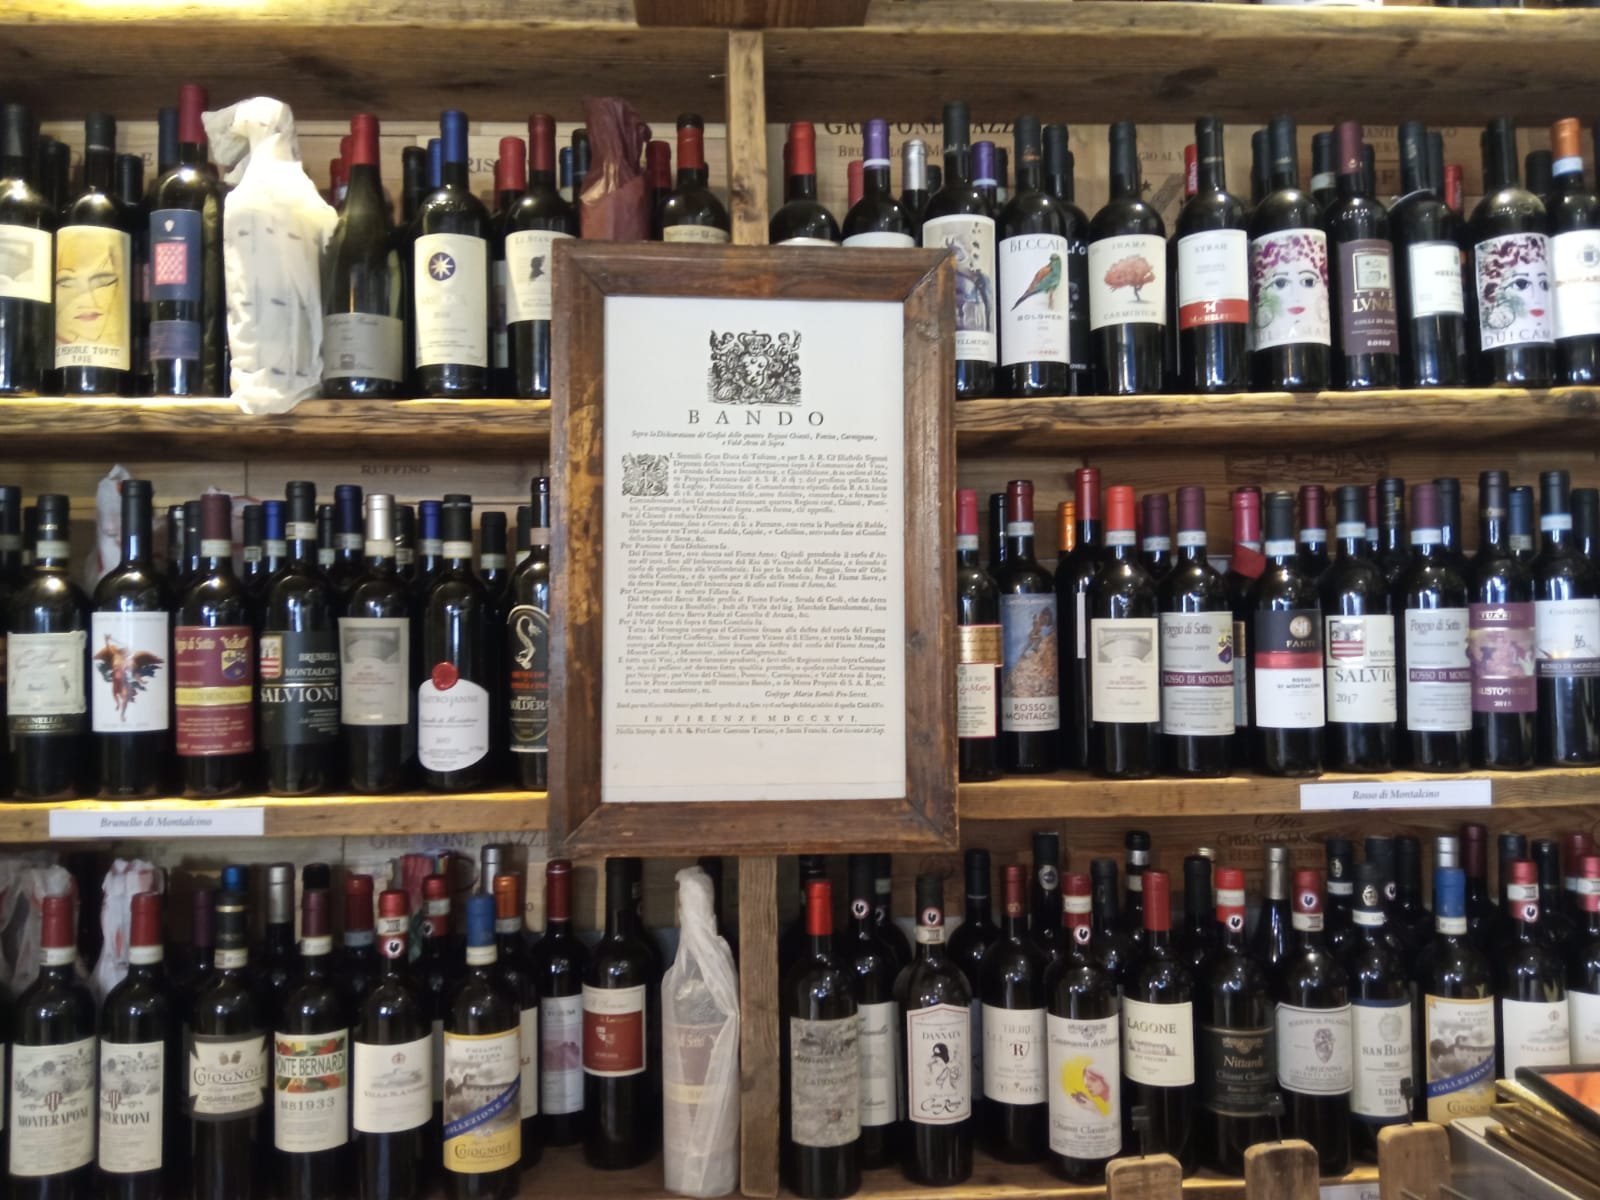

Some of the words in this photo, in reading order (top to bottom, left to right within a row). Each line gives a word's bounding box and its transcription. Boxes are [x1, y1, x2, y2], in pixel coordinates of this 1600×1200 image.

[688, 409, 824, 426] BANDO
[1353, 789, 1378, 800] Rosso
[1379, 789, 1388, 799] di
[1389, 787, 1440, 800] Montalcino
[100, 817, 148, 828] Brunello
[149, 817, 157, 828] di
[158, 816, 212, 828] Montalcino
[1127, 1017, 1177, 1034] LAGONE
